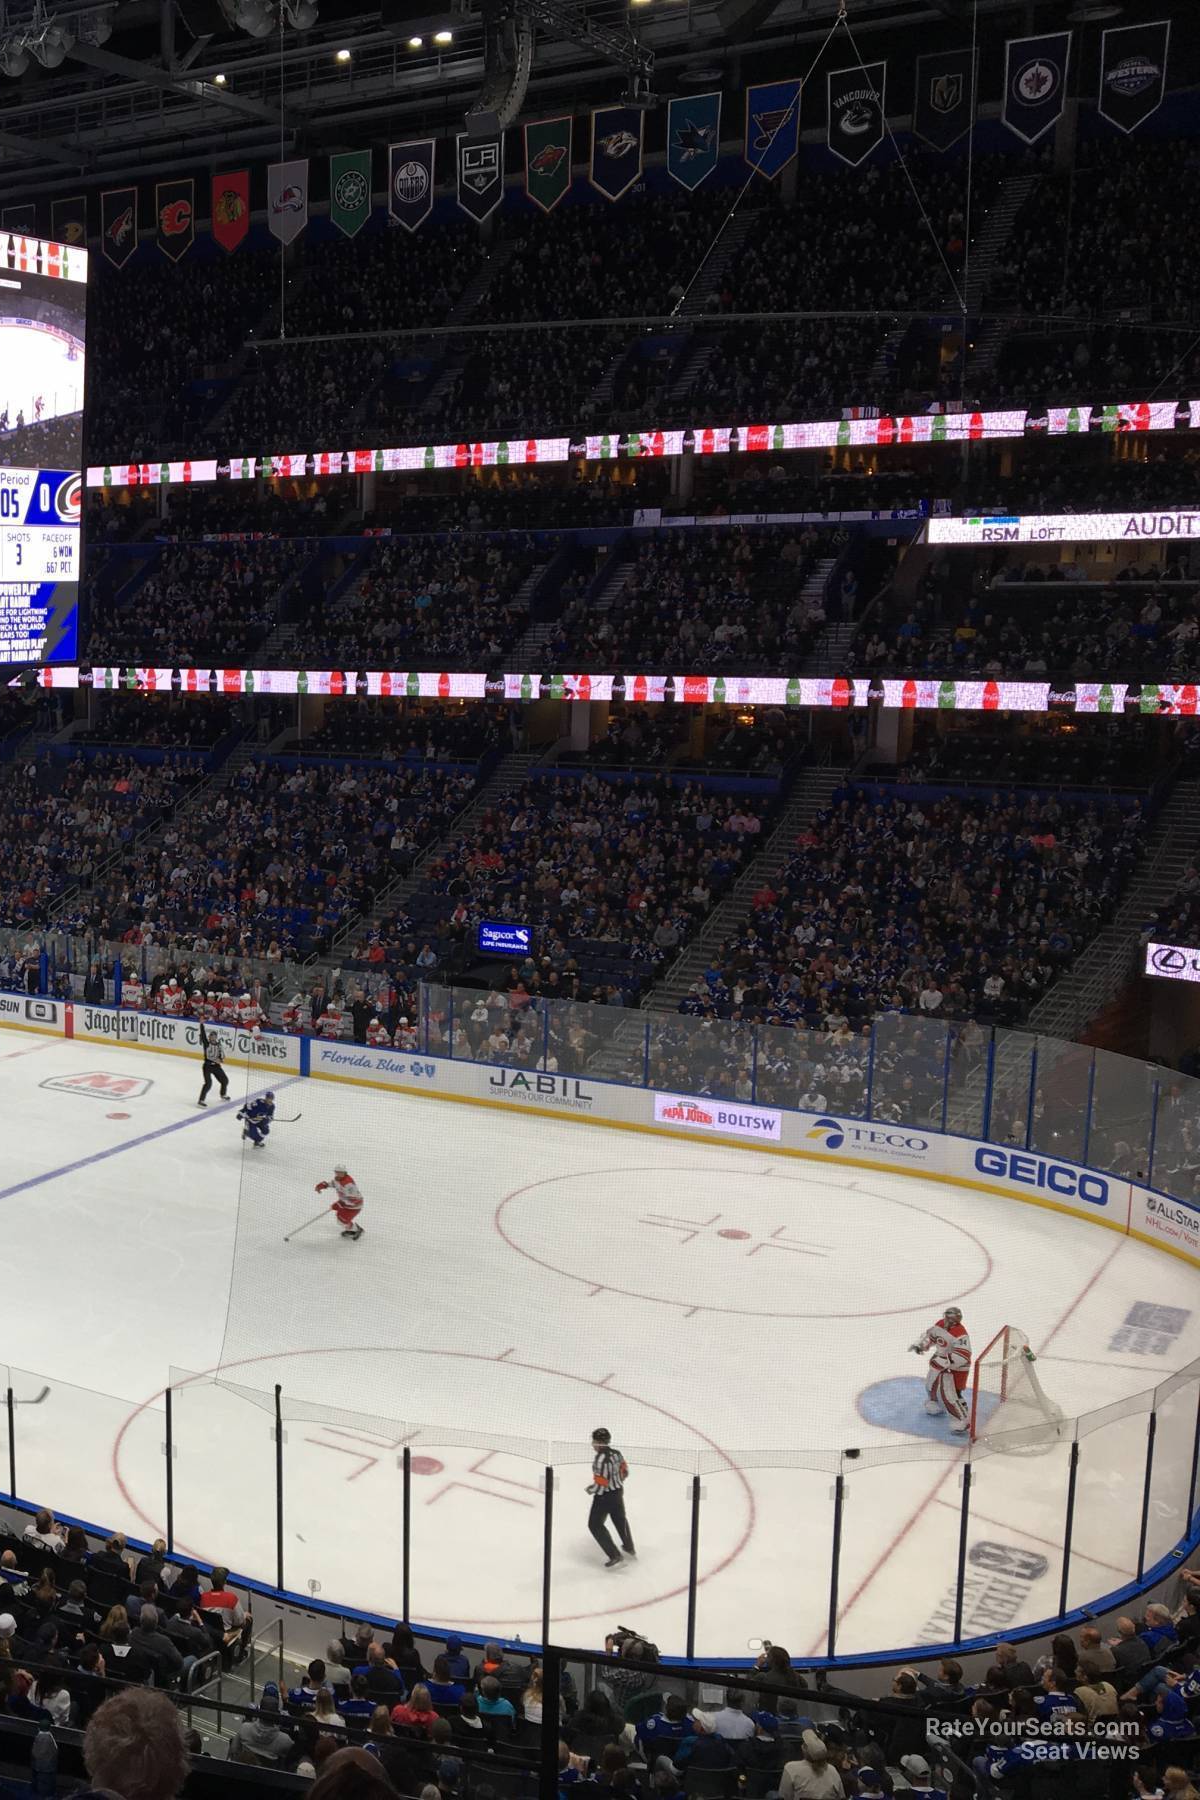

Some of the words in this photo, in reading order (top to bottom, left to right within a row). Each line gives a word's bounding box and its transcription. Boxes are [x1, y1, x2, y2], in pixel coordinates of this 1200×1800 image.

[833, 90, 881, 109] VANCOUVER
[464, 148, 497, 168] LA
[399, 176, 424, 195] OILERS
[0, 472, 29, 485] Period
[39, 483, 50, 512] 0
[982, 527, 1019, 541] RSM
[1030, 527, 1065, 540] LOFT
[1124, 515, 1194, 537] AUDIT
[7, 532, 31, 542] SHOTS
[42, 533, 72, 543] FACEOFF
[16, 543, 22, 565] 3
[59, 545, 73, 557] WON
[0, 583, 22, 596] POWER
[18, 608, 47, 616] LIGHTNING
[21, 616, 43, 624] WORLD!
[19, 623, 46, 631] ORLANDO
[12, 639, 30, 651] POWER
[13, 651, 28, 662] RADIO
[483, 927, 516, 941] Sagicor
[495, 942, 528, 950] INSURANCE
[0, 999, 19, 1013] SUN
[84, 1008, 176, 1041] Jägermeister
[238, 1033, 287, 1059] Times
[320, 1049, 372, 1068] Florida
[375, 1059, 406, 1073] Blue
[489, 1069, 593, 1100] JABIL
[489, 1086, 526, 1100] SUPPORTS
[527, 1093, 544, 1102] OUR
[545, 1096, 593, 1109] COMMUNITY
[662, 1107, 685, 1120] PAPA
[718, 1111, 775, 1131] BOLTSW
[847, 1127, 929, 1151] TECO
[974, 1146, 1108, 1206] GEICO
